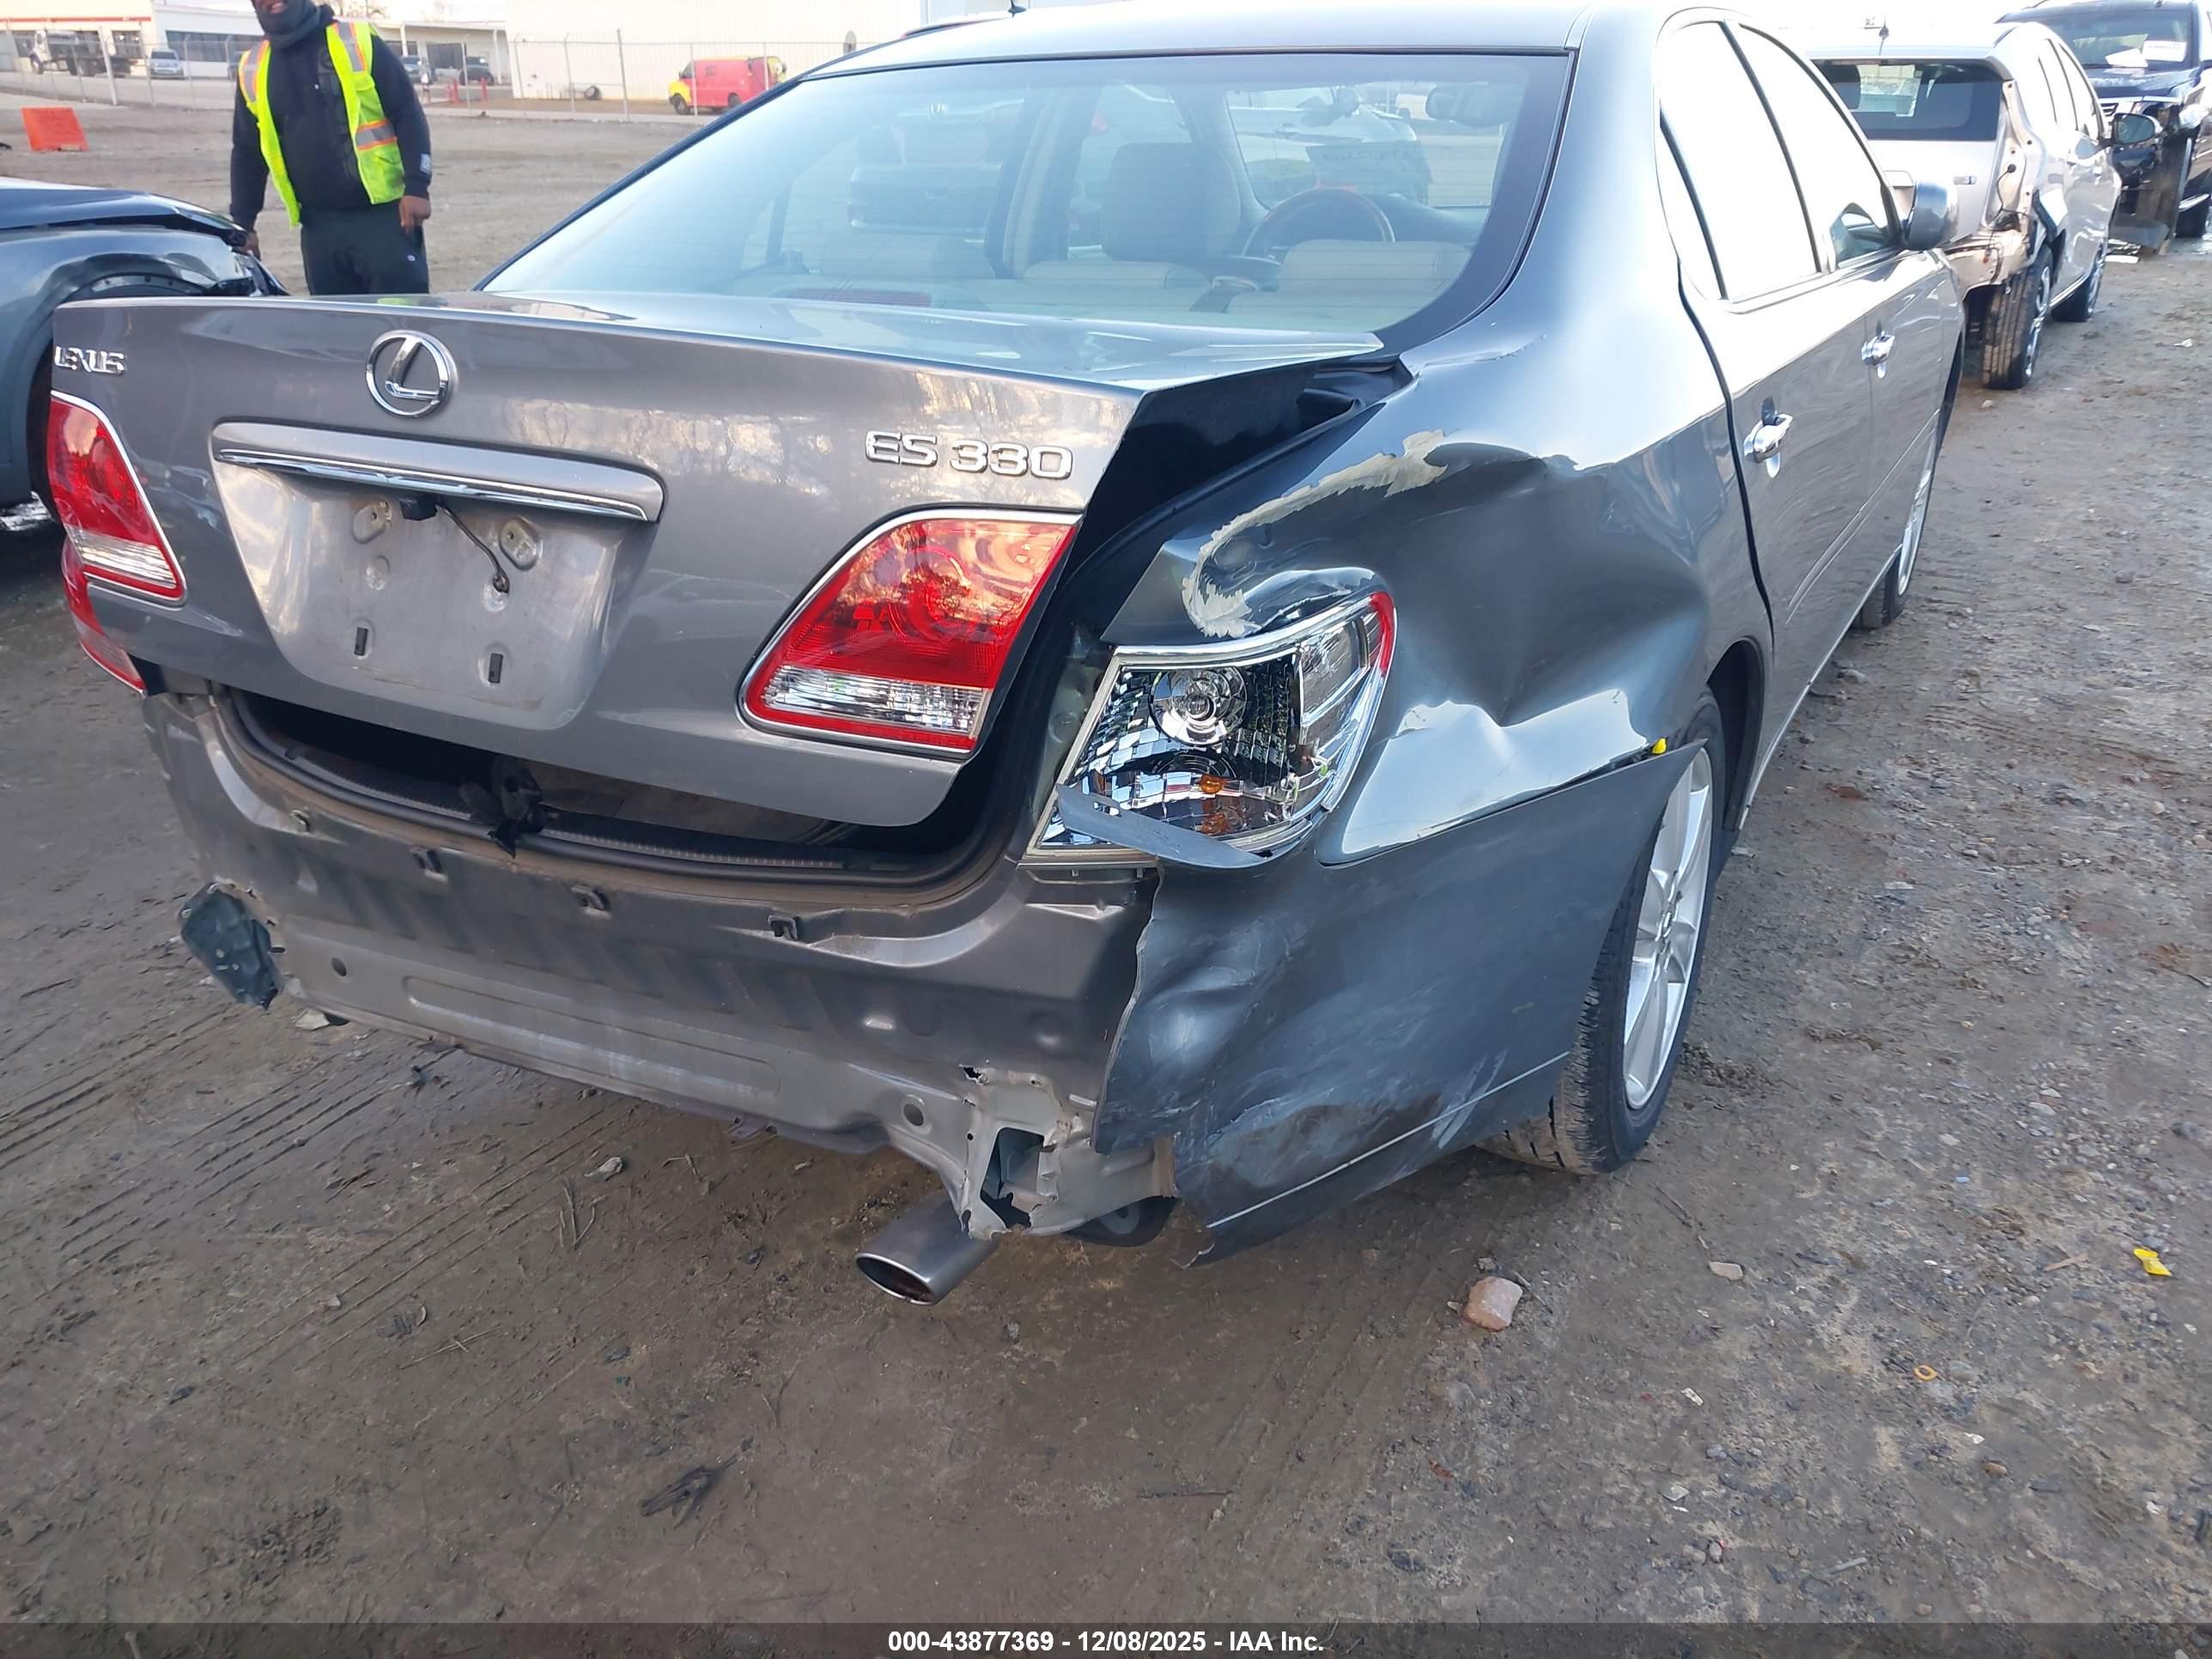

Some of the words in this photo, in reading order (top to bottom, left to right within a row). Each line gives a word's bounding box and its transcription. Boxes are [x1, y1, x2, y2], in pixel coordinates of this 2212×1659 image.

[54, 346, 127, 375] LEXUS
[865, 431, 938, 467] ES
[950, 440, 1073, 479] 330
